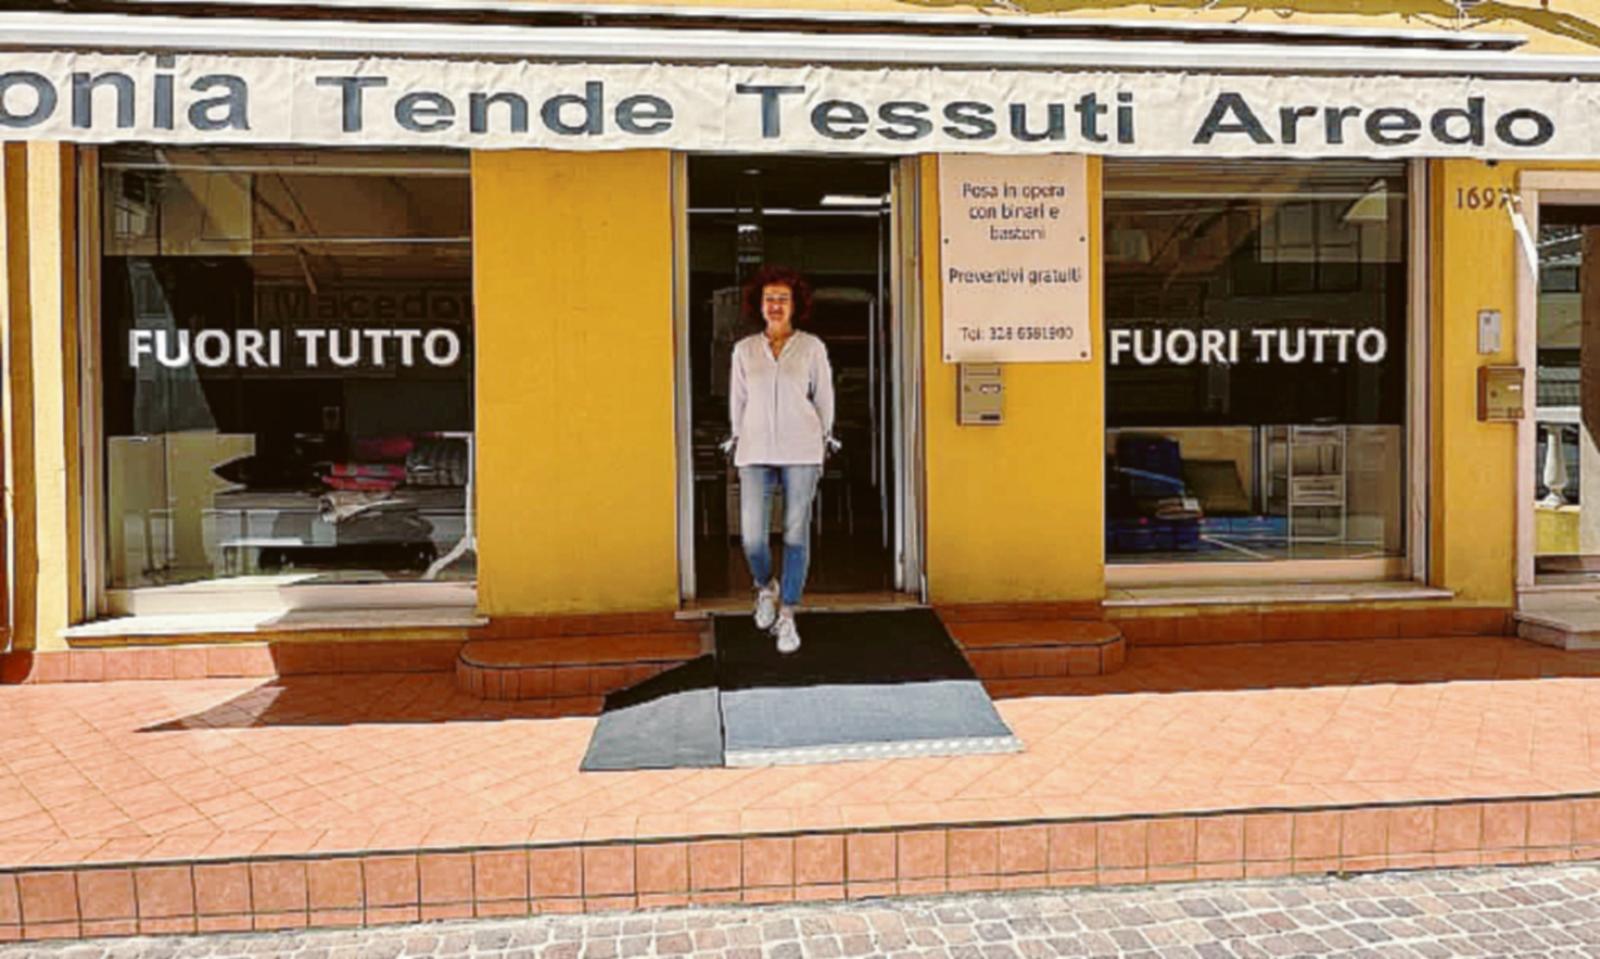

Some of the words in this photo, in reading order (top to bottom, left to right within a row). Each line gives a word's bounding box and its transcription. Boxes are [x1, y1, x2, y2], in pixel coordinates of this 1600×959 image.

[0, 54, 251, 131] onia
[315, 76, 674, 136] Tende
[735, 83, 1135, 144] Tessuti
[1192, 92, 1555, 147] Arredo
[962, 182, 998, 198] Posa
[1003, 181, 1017, 198] in
[1022, 185, 1065, 200] opera
[969, 206, 997, 219] con
[1001, 203, 1044, 219] binari
[1049, 206, 1060, 219] e
[990, 225, 1045, 240] bastoni
[949, 267, 1024, 284] Preventivi
[1028, 267, 1082, 284] gratuiti
[128, 329, 281, 368] FUORI
[296, 328, 460, 367] TUTTO
[1109, 328, 1239, 365] FUORI
[1251, 327, 1387, 363] TUTTO
